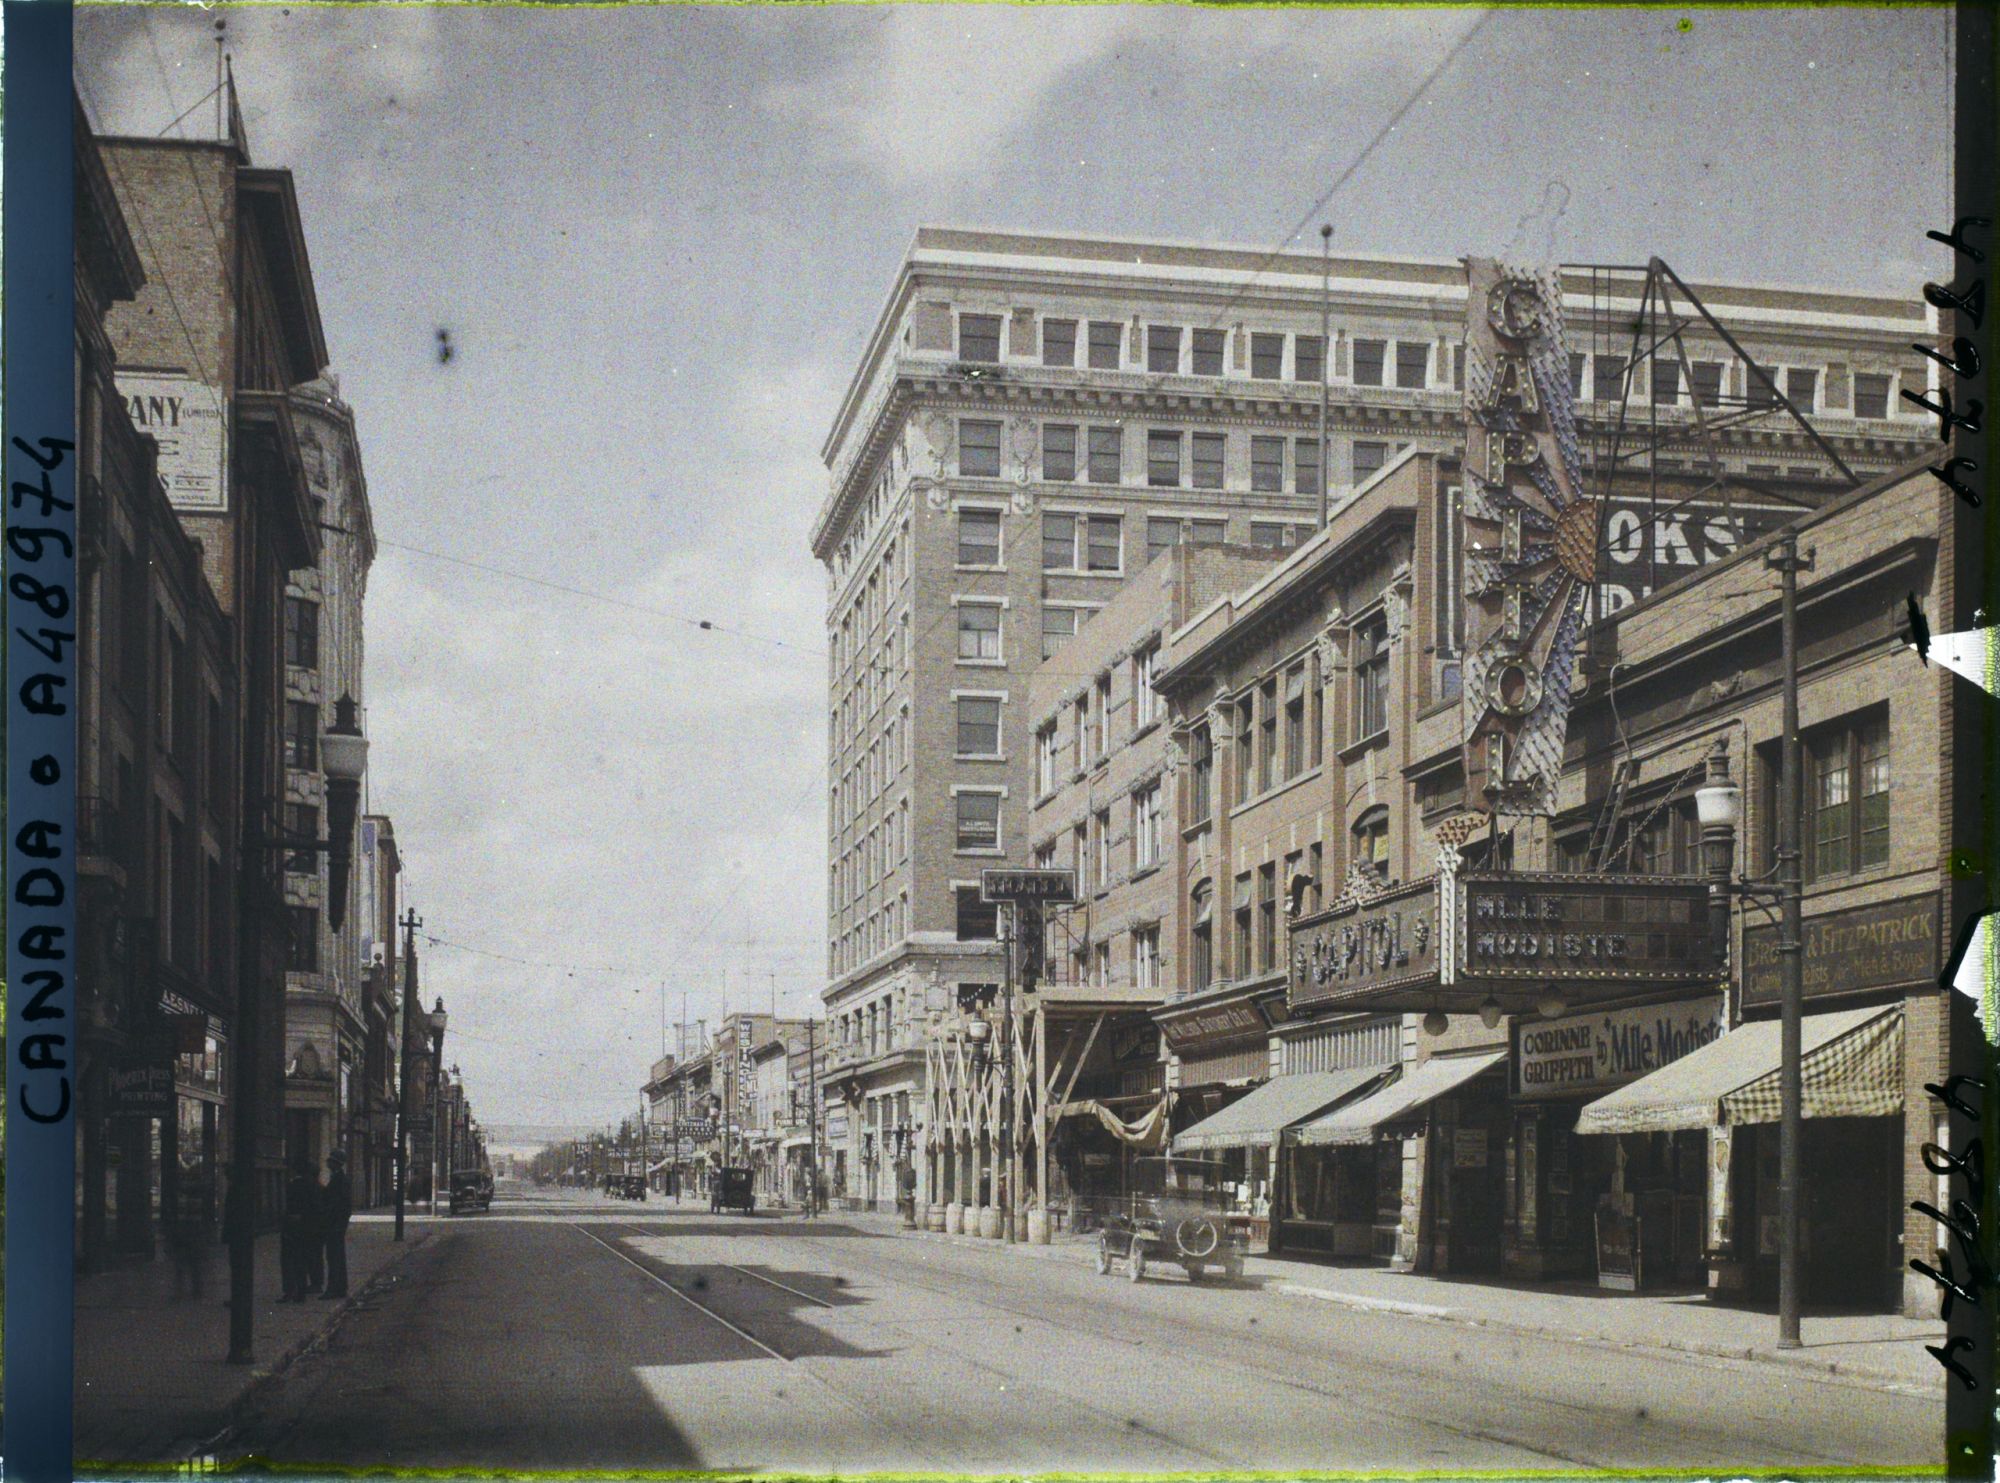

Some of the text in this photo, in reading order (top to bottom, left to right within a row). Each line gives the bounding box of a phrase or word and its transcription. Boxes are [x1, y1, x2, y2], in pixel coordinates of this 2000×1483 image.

[127, 395, 183, 426] ANY
[1485, 280, 1545, 796] CAPITOL
[1476, 895, 1562, 919] MLLE
[1312, 912, 1408, 984] CAPITOL
[1476, 931, 1627, 958] MODISTE
[1821, 913, 1932, 956] FITZPATRICK
[1523, 1025, 1592, 1056] CORINNE
[1523, 1056, 1596, 1084] GRIFFITH
